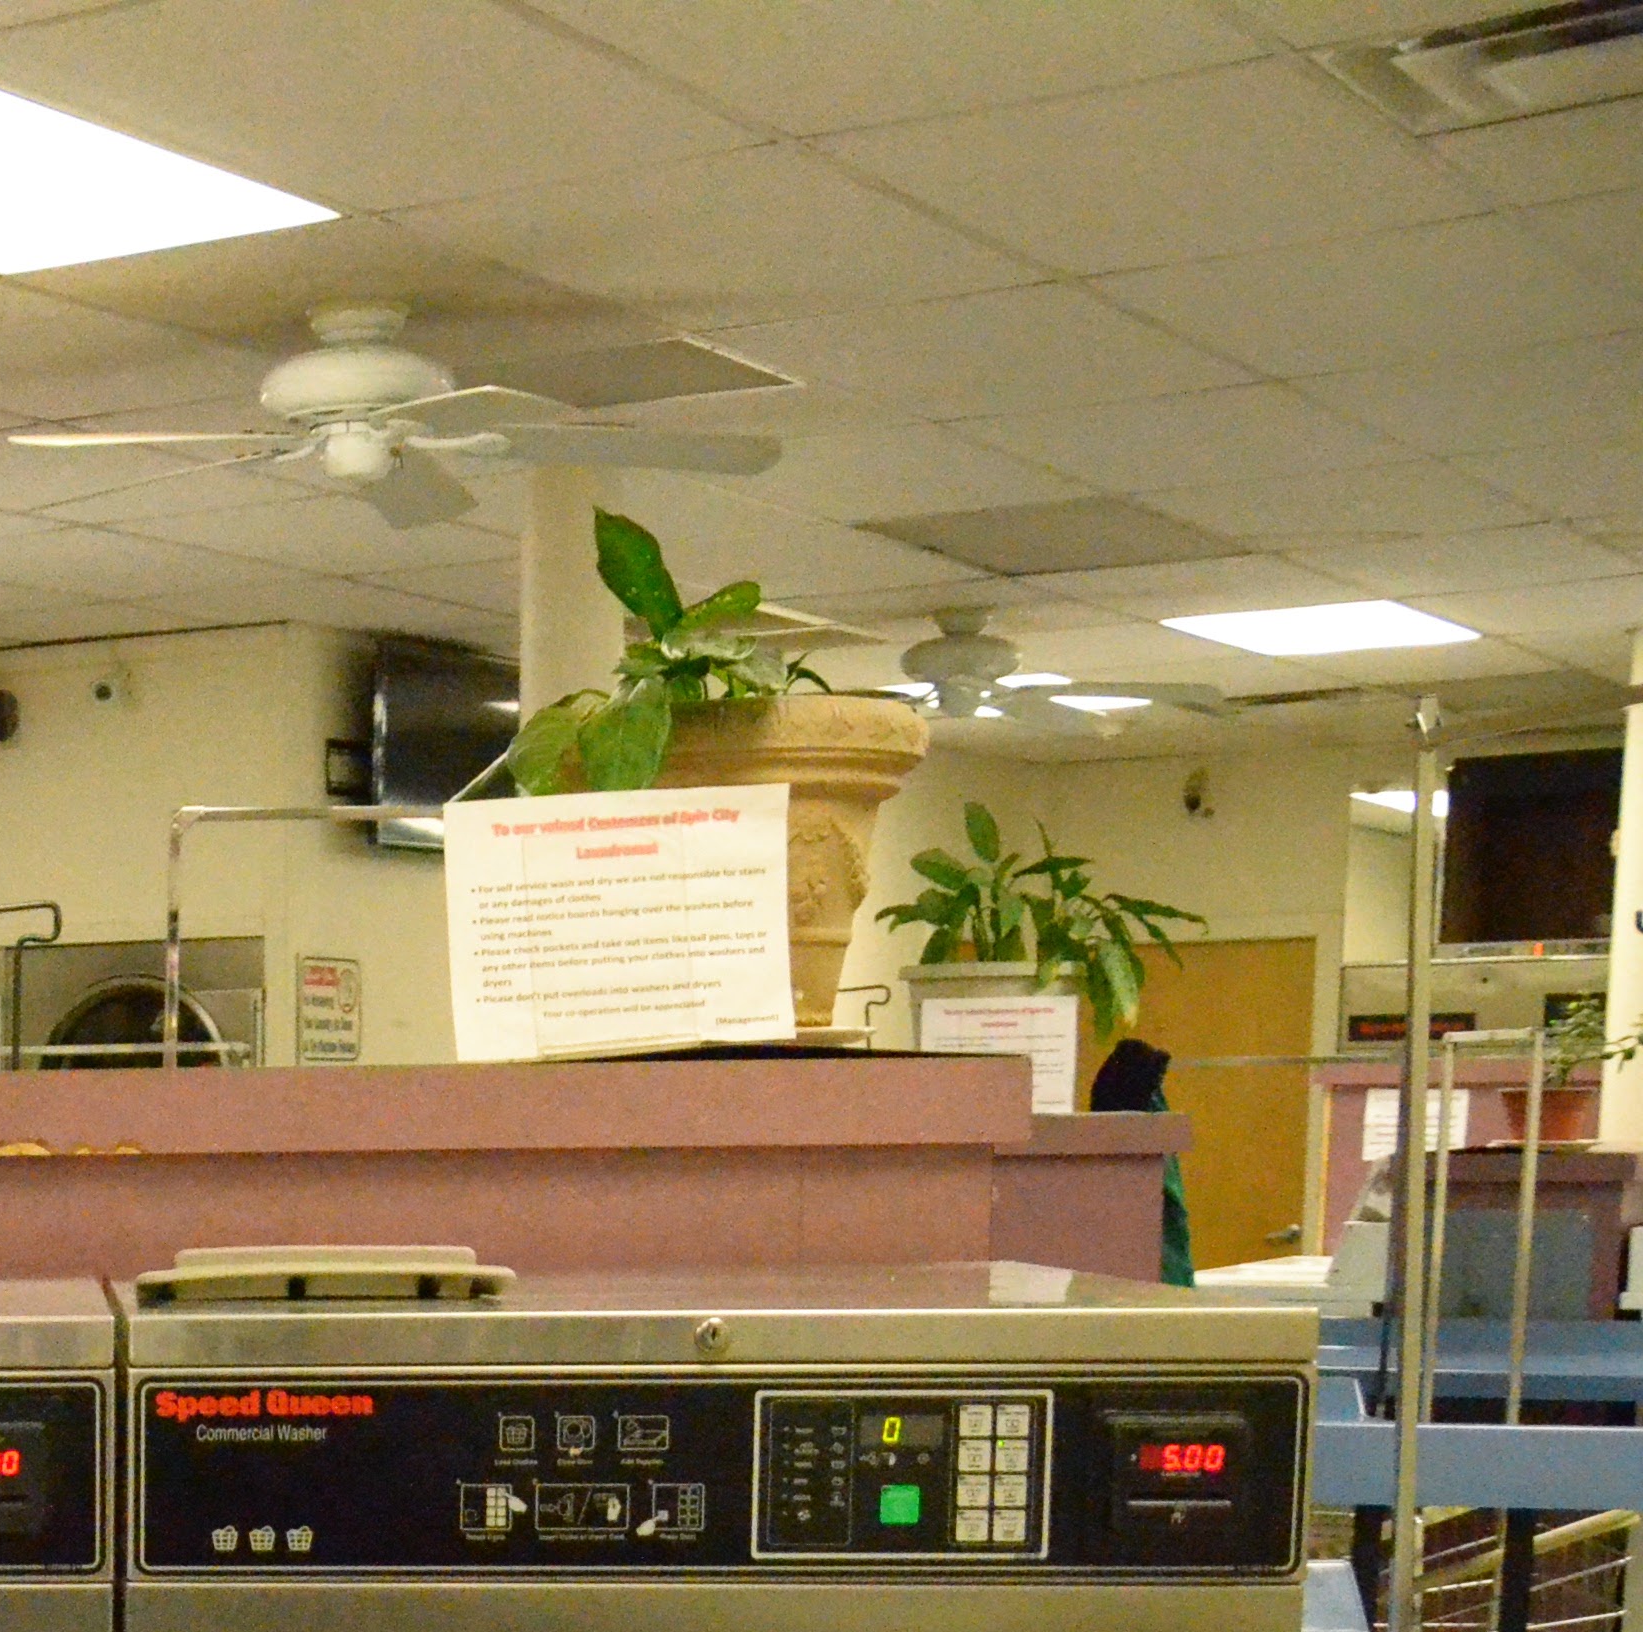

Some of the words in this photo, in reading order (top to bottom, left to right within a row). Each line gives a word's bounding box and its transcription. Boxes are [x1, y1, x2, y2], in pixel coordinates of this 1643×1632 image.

[551, 879, 574, 889] wash
[578, 877, 595, 887] and
[739, 866, 766, 875] stains
[155, 1389, 261, 1423] Speed
[266, 1389, 374, 1416] Queen
[196, 1423, 275, 1442] Commercial
[277, 1424, 327, 1441] Washer
[882, 1416, 902, 1444] 0
